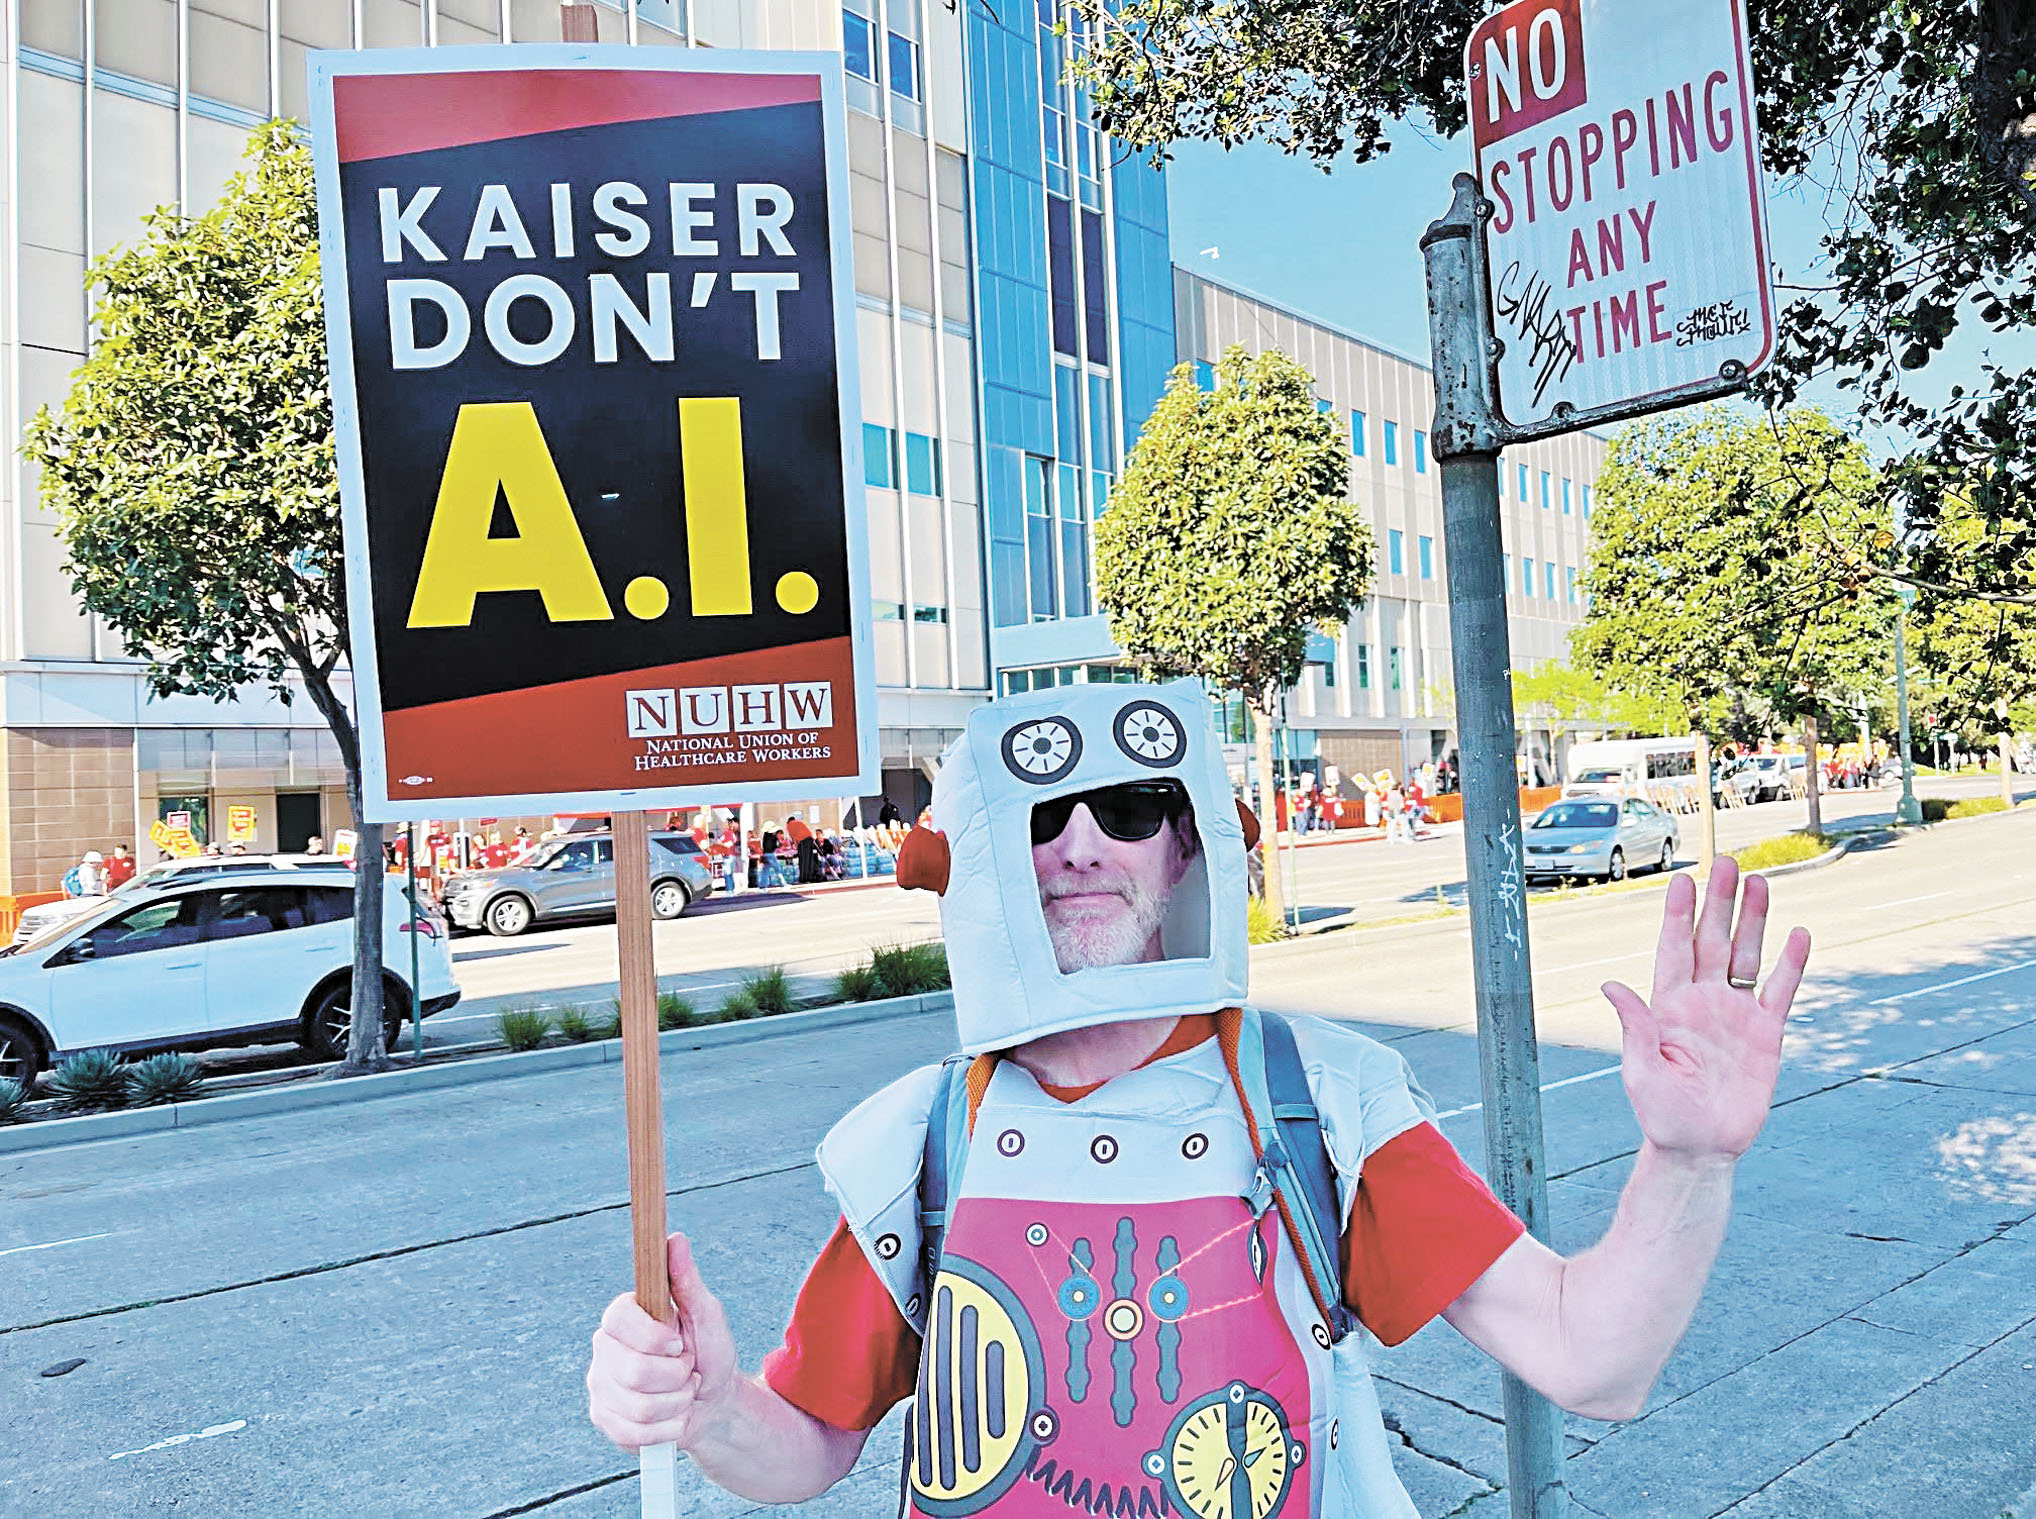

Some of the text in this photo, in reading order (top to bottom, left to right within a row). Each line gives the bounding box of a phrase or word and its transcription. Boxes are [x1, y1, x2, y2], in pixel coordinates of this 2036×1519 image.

[1483, 9, 1566, 124] NO
[1491, 70, 1733, 234] STOPPING
[377, 181, 797, 263] KAISER
[1567, 201, 1656, 288] ANY
[386, 272, 800, 370] DON'T
[1566, 280, 1673, 364] TIME
[406, 396, 819, 629] A.I.
[630, 685, 830, 733] NUHW
[646, 731, 819, 754] NATIONAL UNION OF
[634, 746, 832, 771] HEALTHCARE WORKERS
